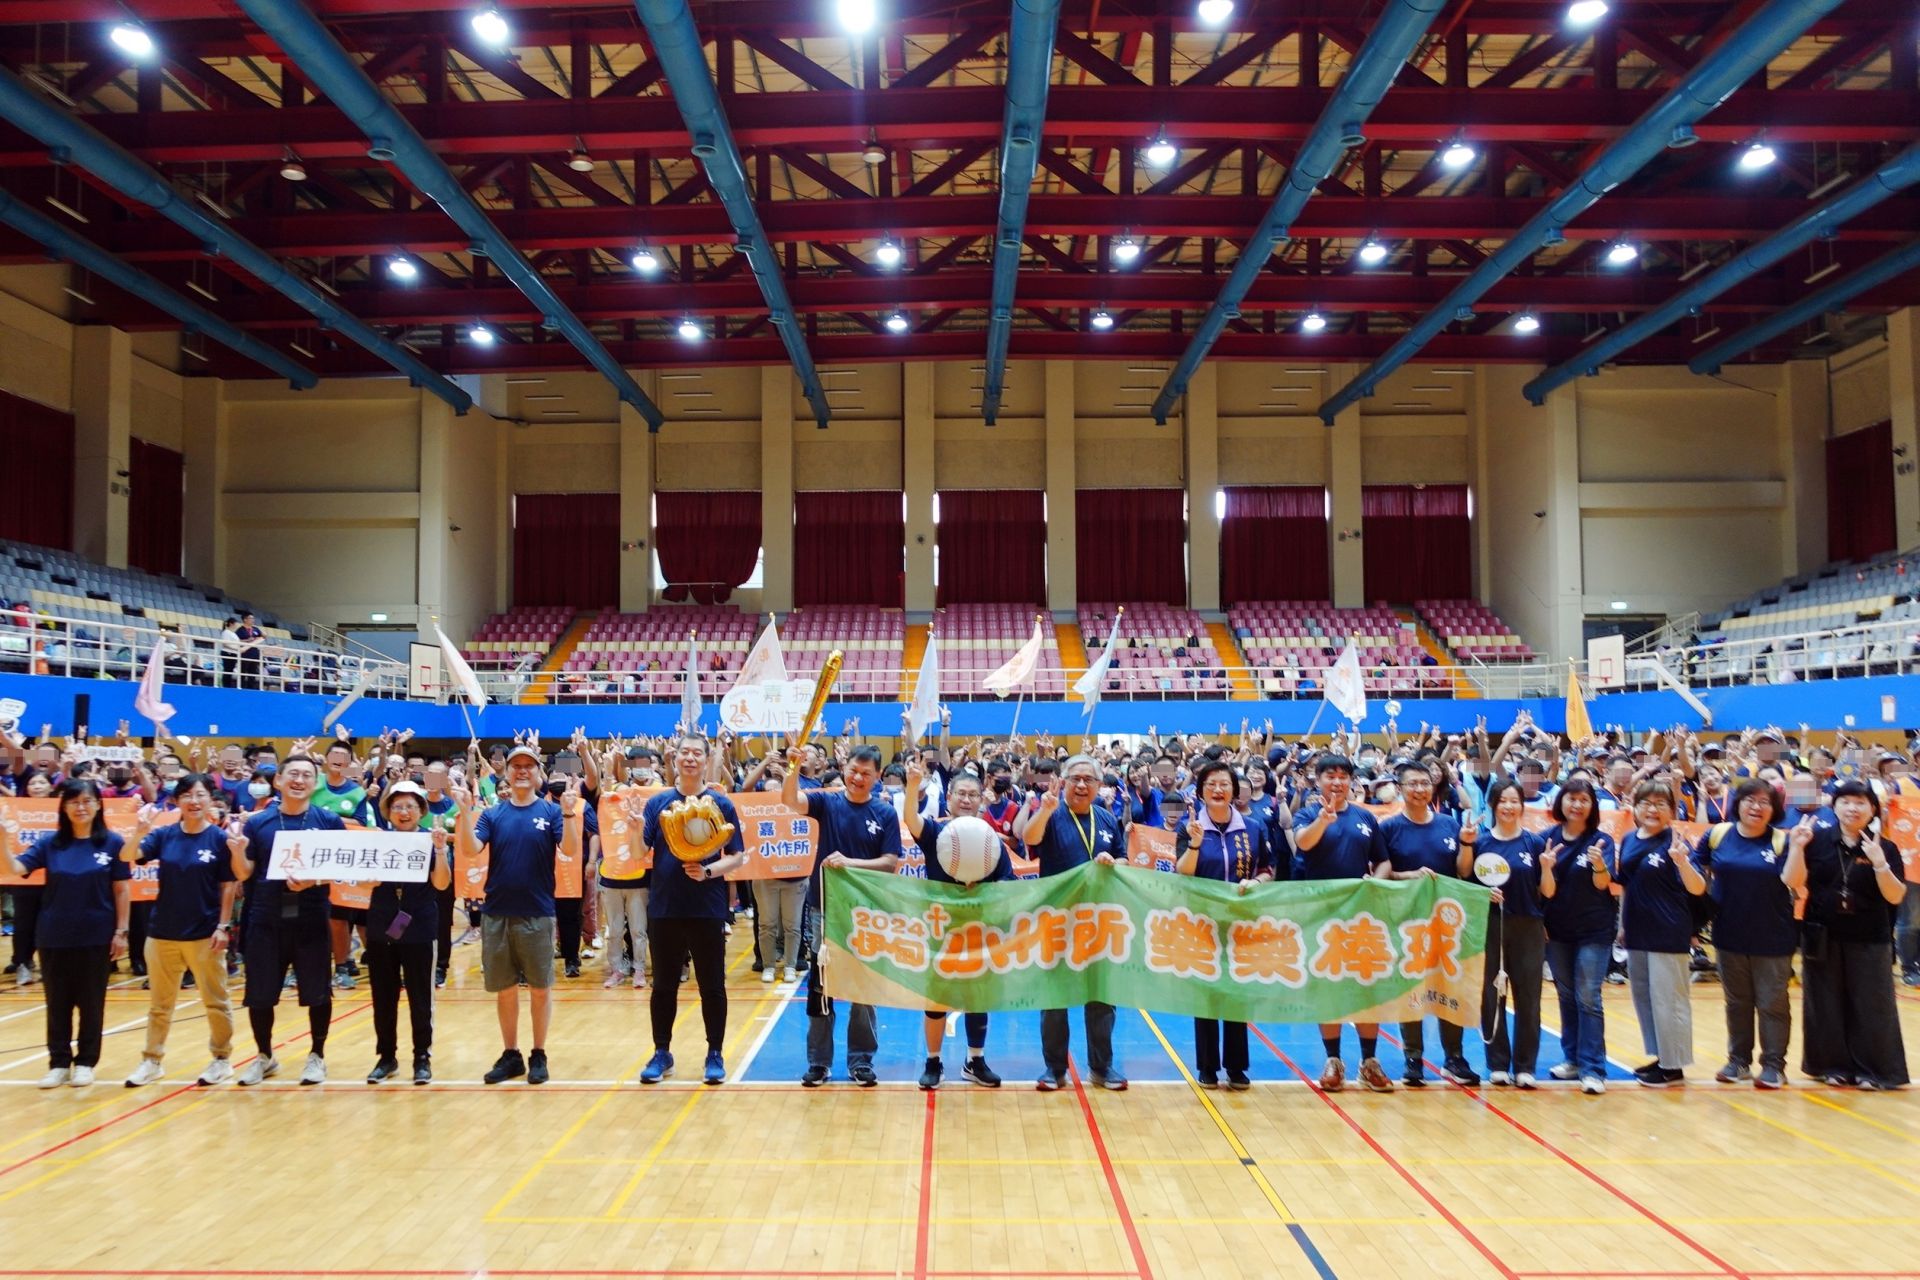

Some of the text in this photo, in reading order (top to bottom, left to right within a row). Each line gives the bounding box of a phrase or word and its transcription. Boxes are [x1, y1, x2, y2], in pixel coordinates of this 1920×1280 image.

[311, 847, 428, 871] 伊甸基金會
[760, 841, 809, 857] 小作所
[855, 911, 925, 937] 2024
